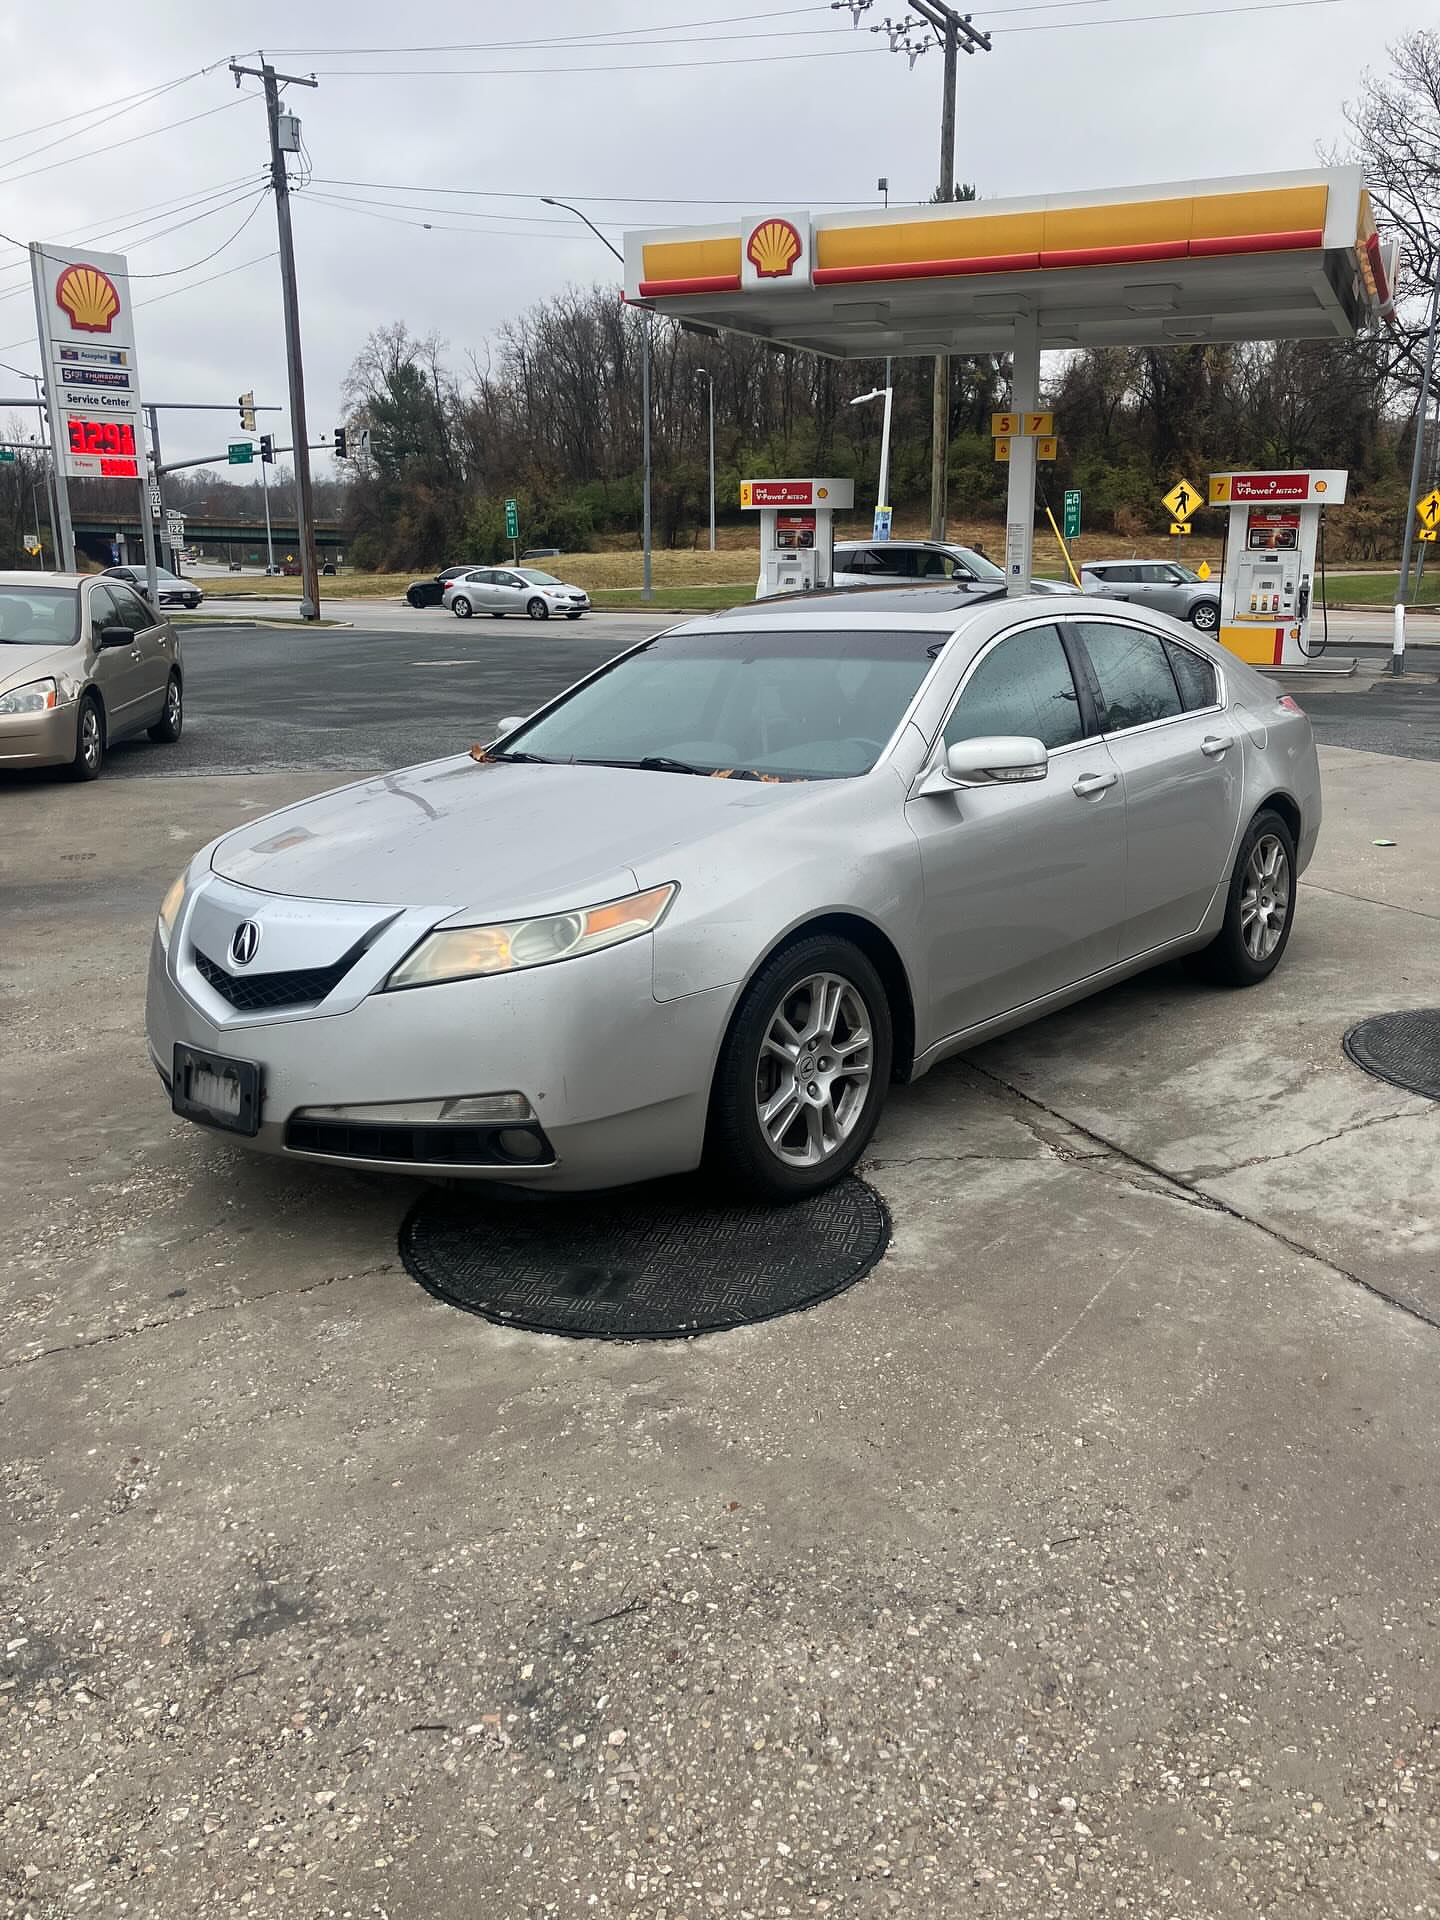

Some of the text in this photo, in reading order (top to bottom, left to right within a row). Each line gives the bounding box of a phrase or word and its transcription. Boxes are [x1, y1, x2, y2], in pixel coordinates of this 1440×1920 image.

[67, 393, 130, 407] Service Center
[1000, 417, 1010, 431] 5
[1032, 416, 1043, 431] 7
[1000, 445, 1007, 453] 6
[743, 488, 749, 500] 5
[1217, 483, 1225, 495] 7
[1237, 487, 1273, 495] V-Power
[169, 525, 184, 534] 122
